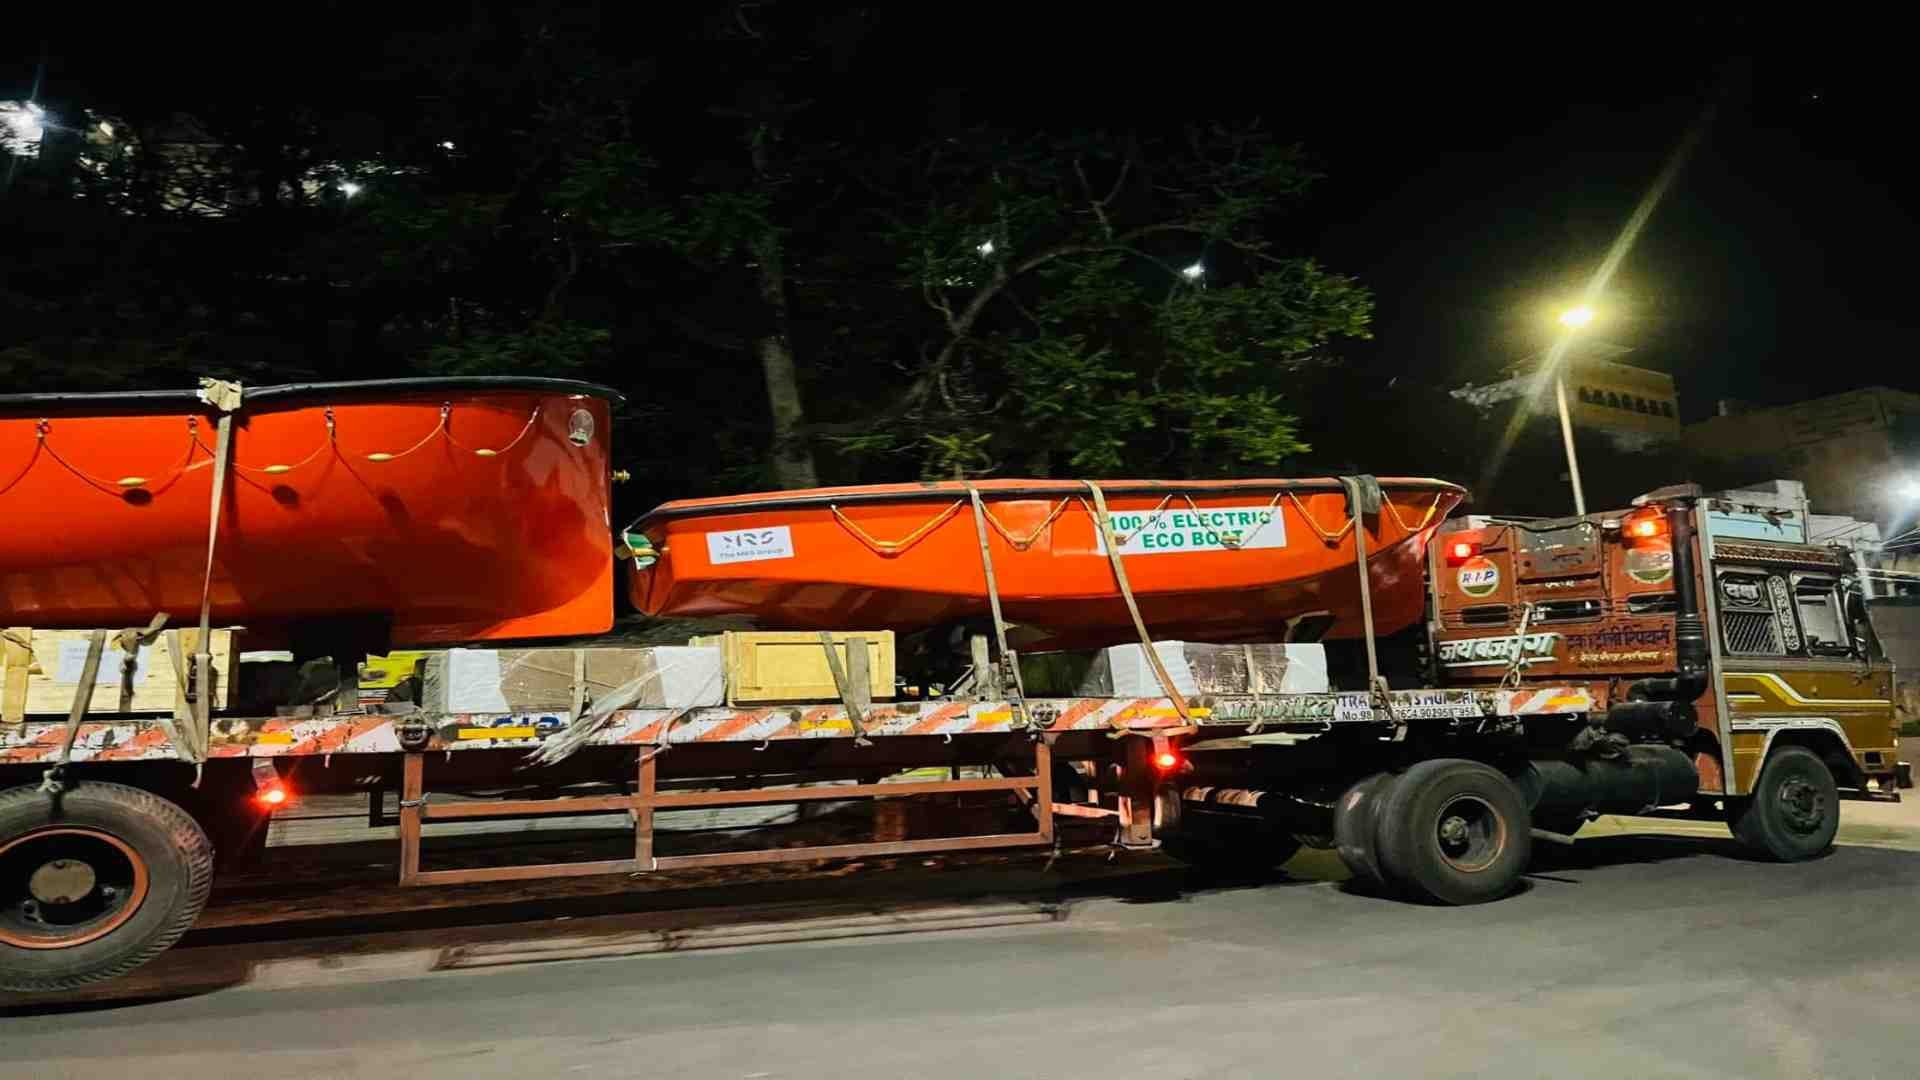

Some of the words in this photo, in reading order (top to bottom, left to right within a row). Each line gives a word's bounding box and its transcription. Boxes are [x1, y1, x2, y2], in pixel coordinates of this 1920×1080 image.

[1109, 515, 1142, 531] 100
[1172, 511, 1272, 528] ELECTRIC
[1142, 532, 1185, 549] ECO
